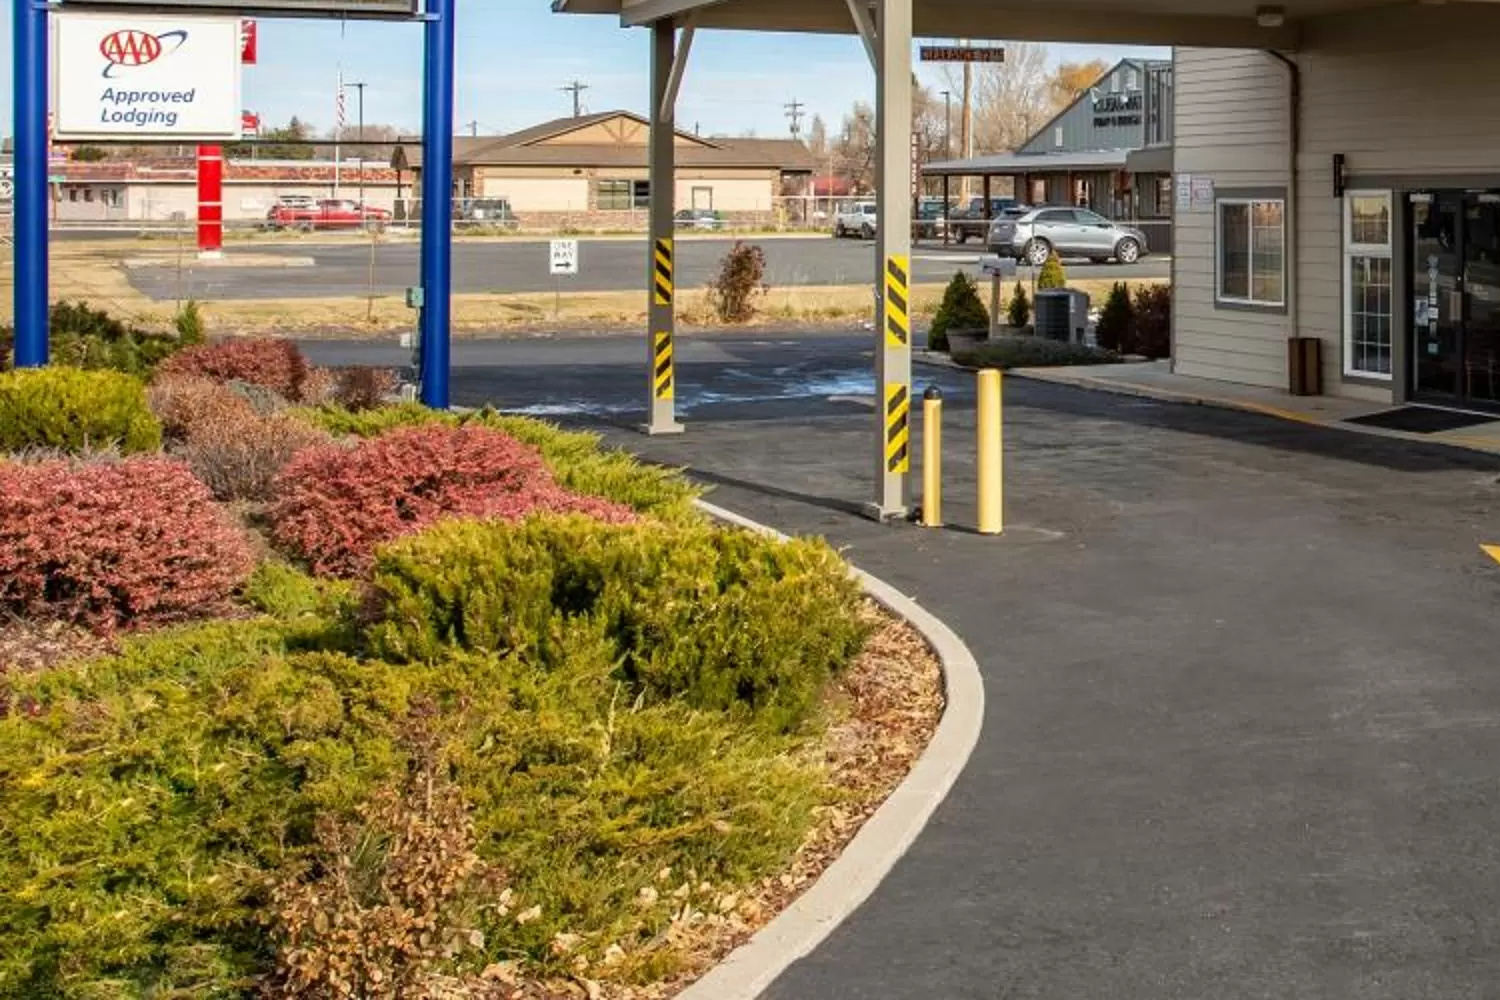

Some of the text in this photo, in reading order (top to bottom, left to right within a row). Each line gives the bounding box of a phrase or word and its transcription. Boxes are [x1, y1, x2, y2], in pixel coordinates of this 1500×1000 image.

[103, 30, 158, 66] AAA
[101, 87, 196, 106] Approved
[101, 107, 178, 127] Lodging
